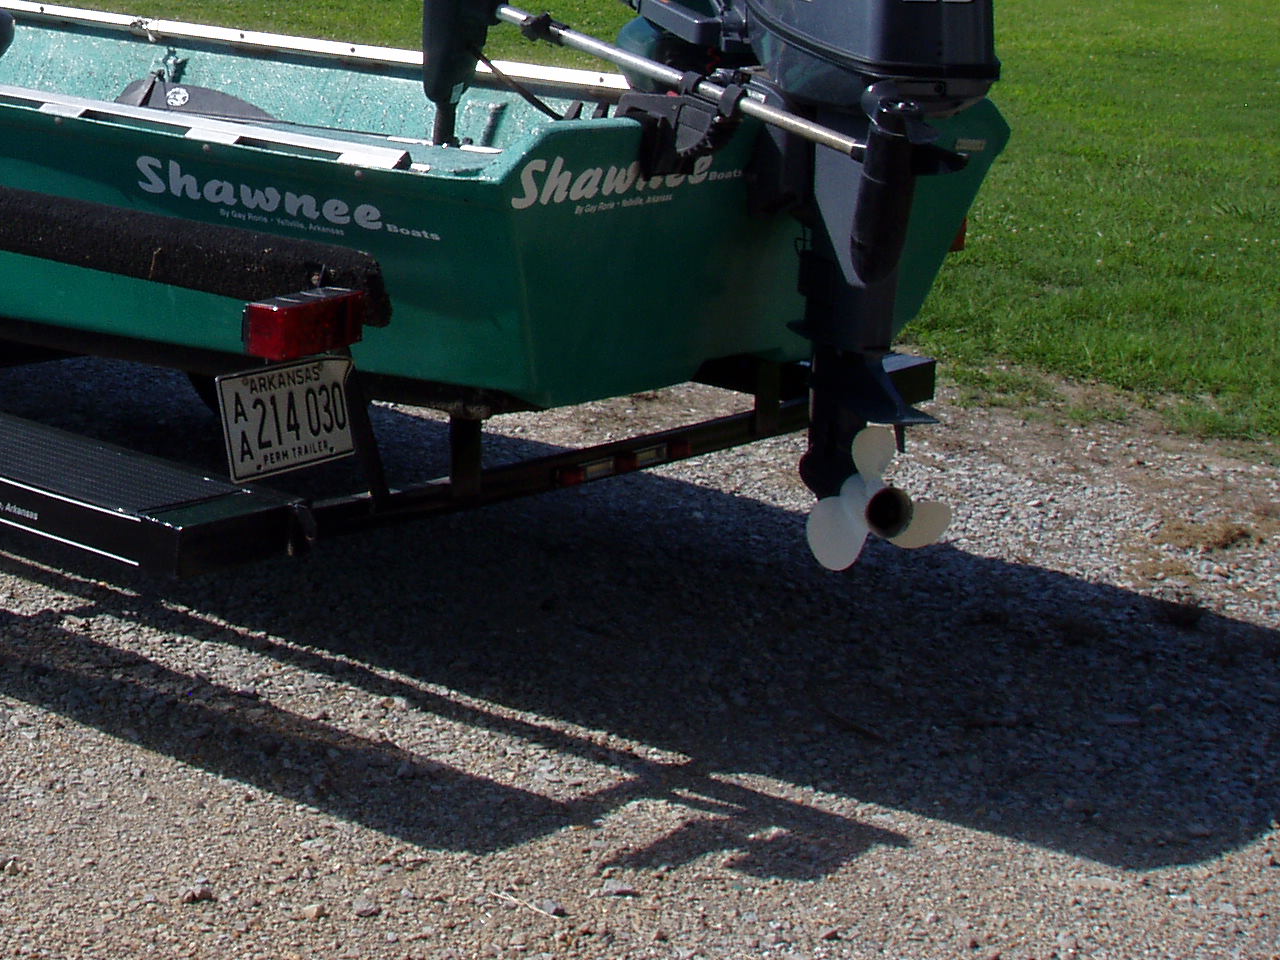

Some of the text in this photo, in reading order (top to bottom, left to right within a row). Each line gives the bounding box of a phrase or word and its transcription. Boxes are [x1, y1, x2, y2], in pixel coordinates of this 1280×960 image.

[136, 155, 441, 241] Shawnee Boats
[511, 155, 713, 209] Shawe
[250, 365, 321, 395] ARKANSAS
[252, 382, 346, 450] 214 030
[263, 440, 329, 466] PERM TRAILER
